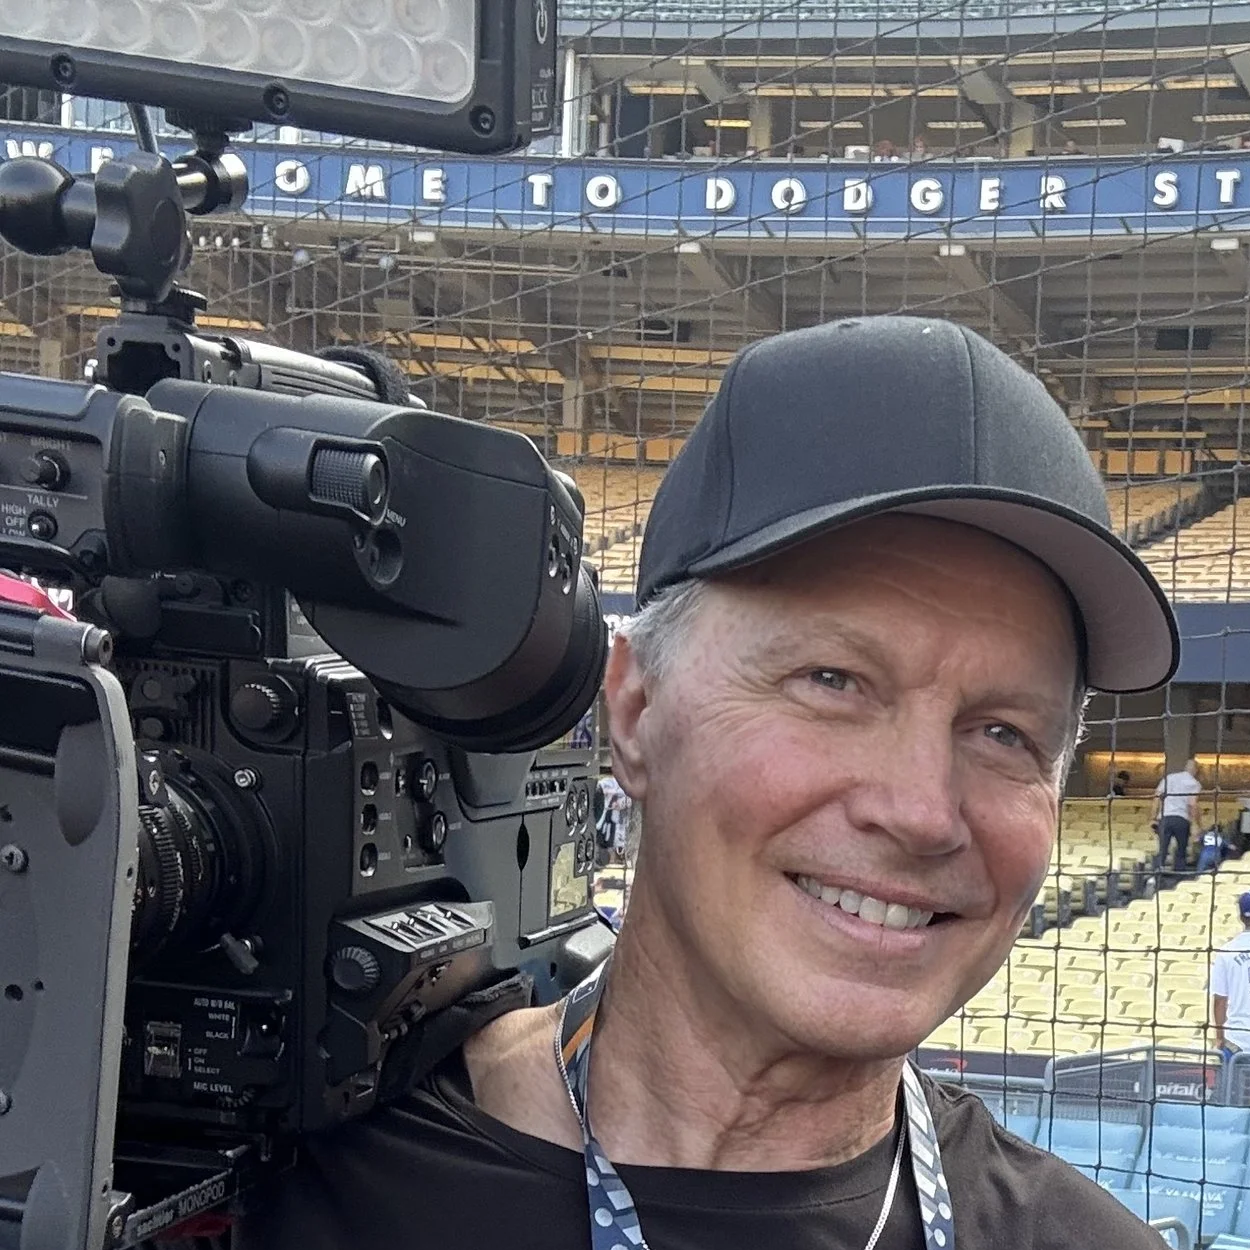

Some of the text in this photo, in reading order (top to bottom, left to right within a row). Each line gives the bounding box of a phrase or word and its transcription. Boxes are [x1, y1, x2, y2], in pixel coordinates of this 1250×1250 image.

[528, 173, 623, 210] TO
[705, 175, 1068, 214] DODGER
[27, 494, 59, 508] TALLY
[1, 503, 26, 515] HIGH
[5, 516, 25, 528] OFF
[208, 1012, 230, 1022] WHITE
[205, 1030, 229, 1039] BLACK
[193, 1066, 220, 1075] SELECT
[193, 1081, 234, 1094] MIC LEVEL
[178, 1180, 225, 1216] MONOPOD
